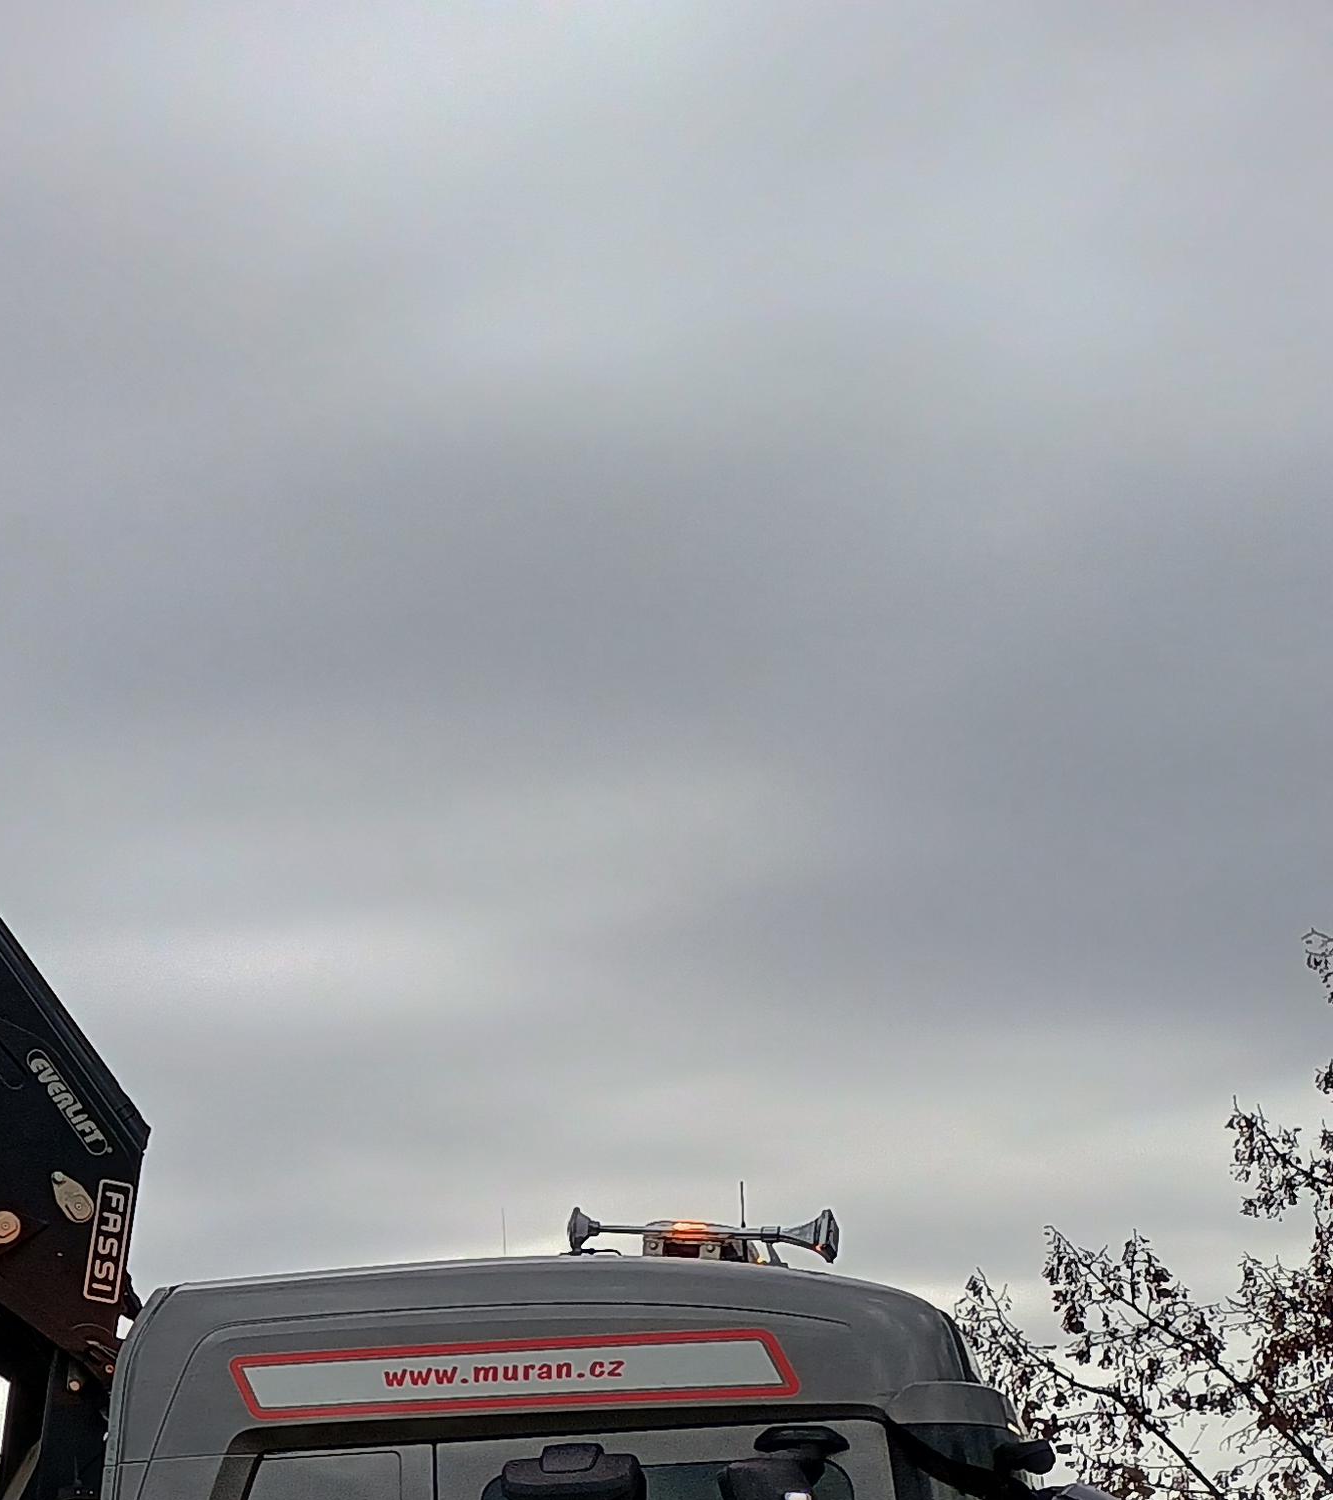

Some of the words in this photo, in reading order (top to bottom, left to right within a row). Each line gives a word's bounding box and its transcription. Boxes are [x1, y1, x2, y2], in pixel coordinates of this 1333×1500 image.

[29, 1058, 105, 1143] EVERLIFT
[89, 1191, 125, 1294] FASSI
[384, 1359, 624, 1387] www.muran.cz
